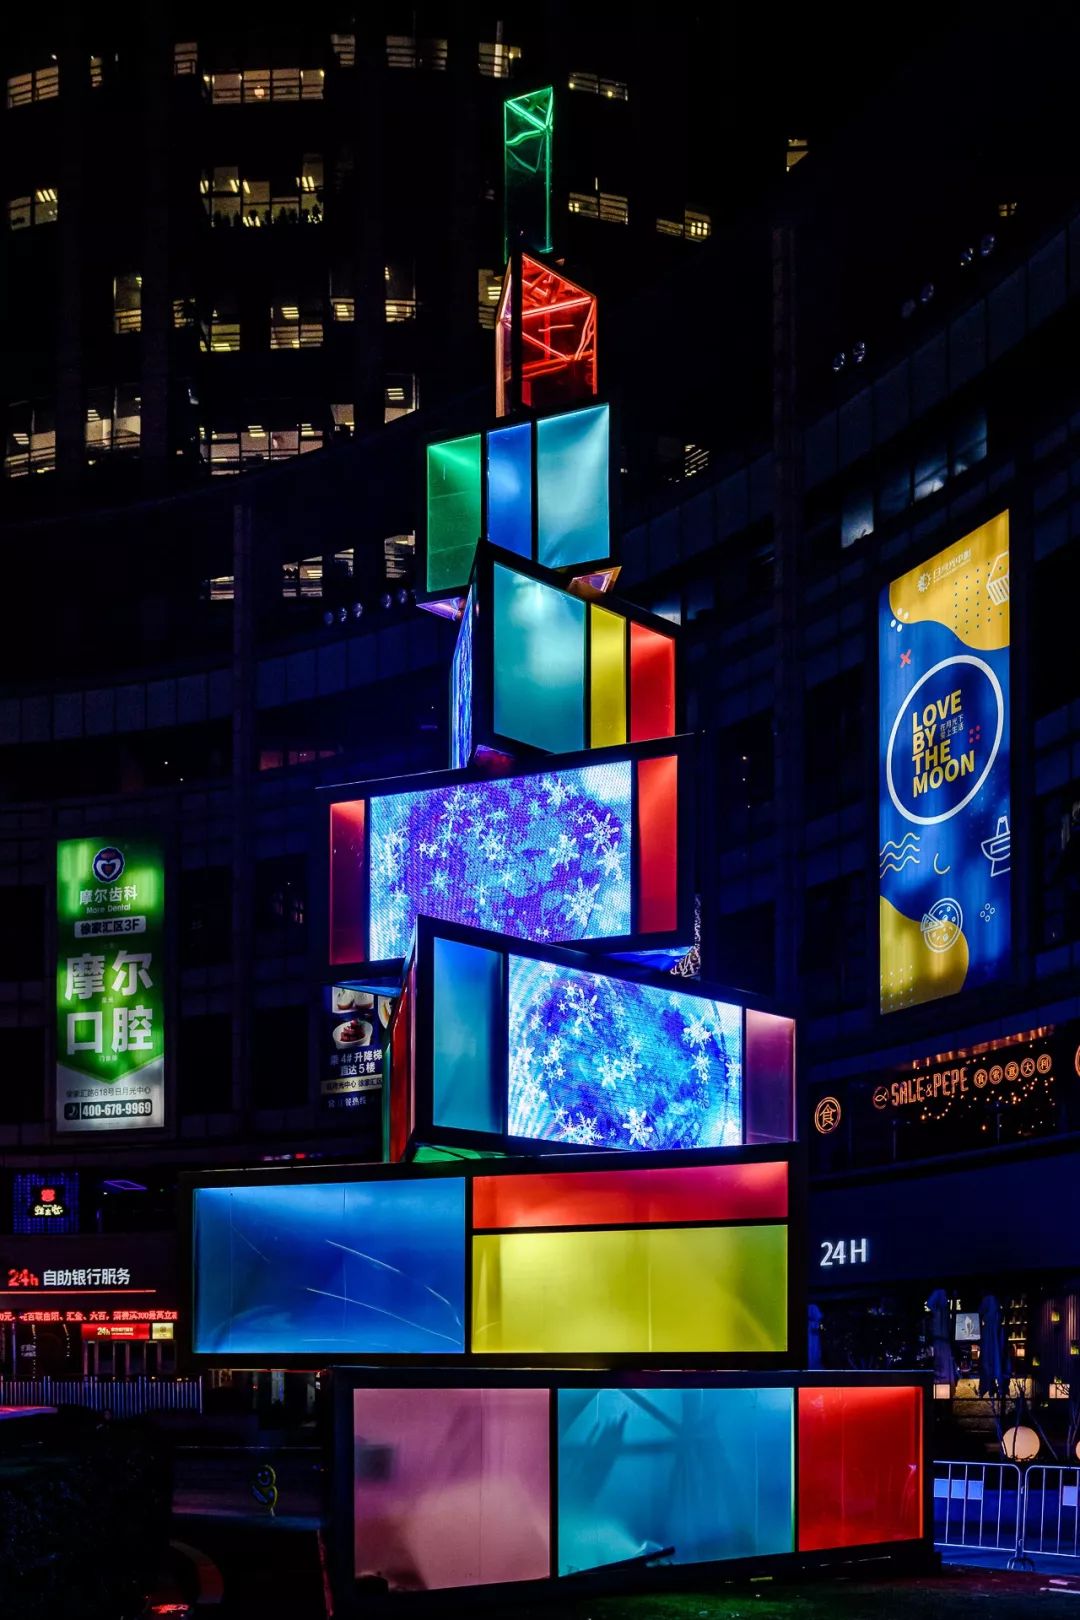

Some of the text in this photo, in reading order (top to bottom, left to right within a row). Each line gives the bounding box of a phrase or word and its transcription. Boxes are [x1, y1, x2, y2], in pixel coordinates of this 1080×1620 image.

[913, 690, 962, 733] LOVE
[913, 724, 936, 755] BY
[912, 740, 951, 774] THE
[913, 751, 975, 798] MOON
[80, 885, 138, 905] 摩尔齿科
[107, 903, 131, 912] Dental
[81, 919, 140, 936] 徐家汇区3F
[65, 950, 152, 1000] 摩尔
[66, 1005, 153, 1055] 口腔
[82, 1102, 151, 1117] 400-678-9969
[818, 1101, 838, 1129] 食
[8, 1268, 131, 1287] 24h 自助银行服务
